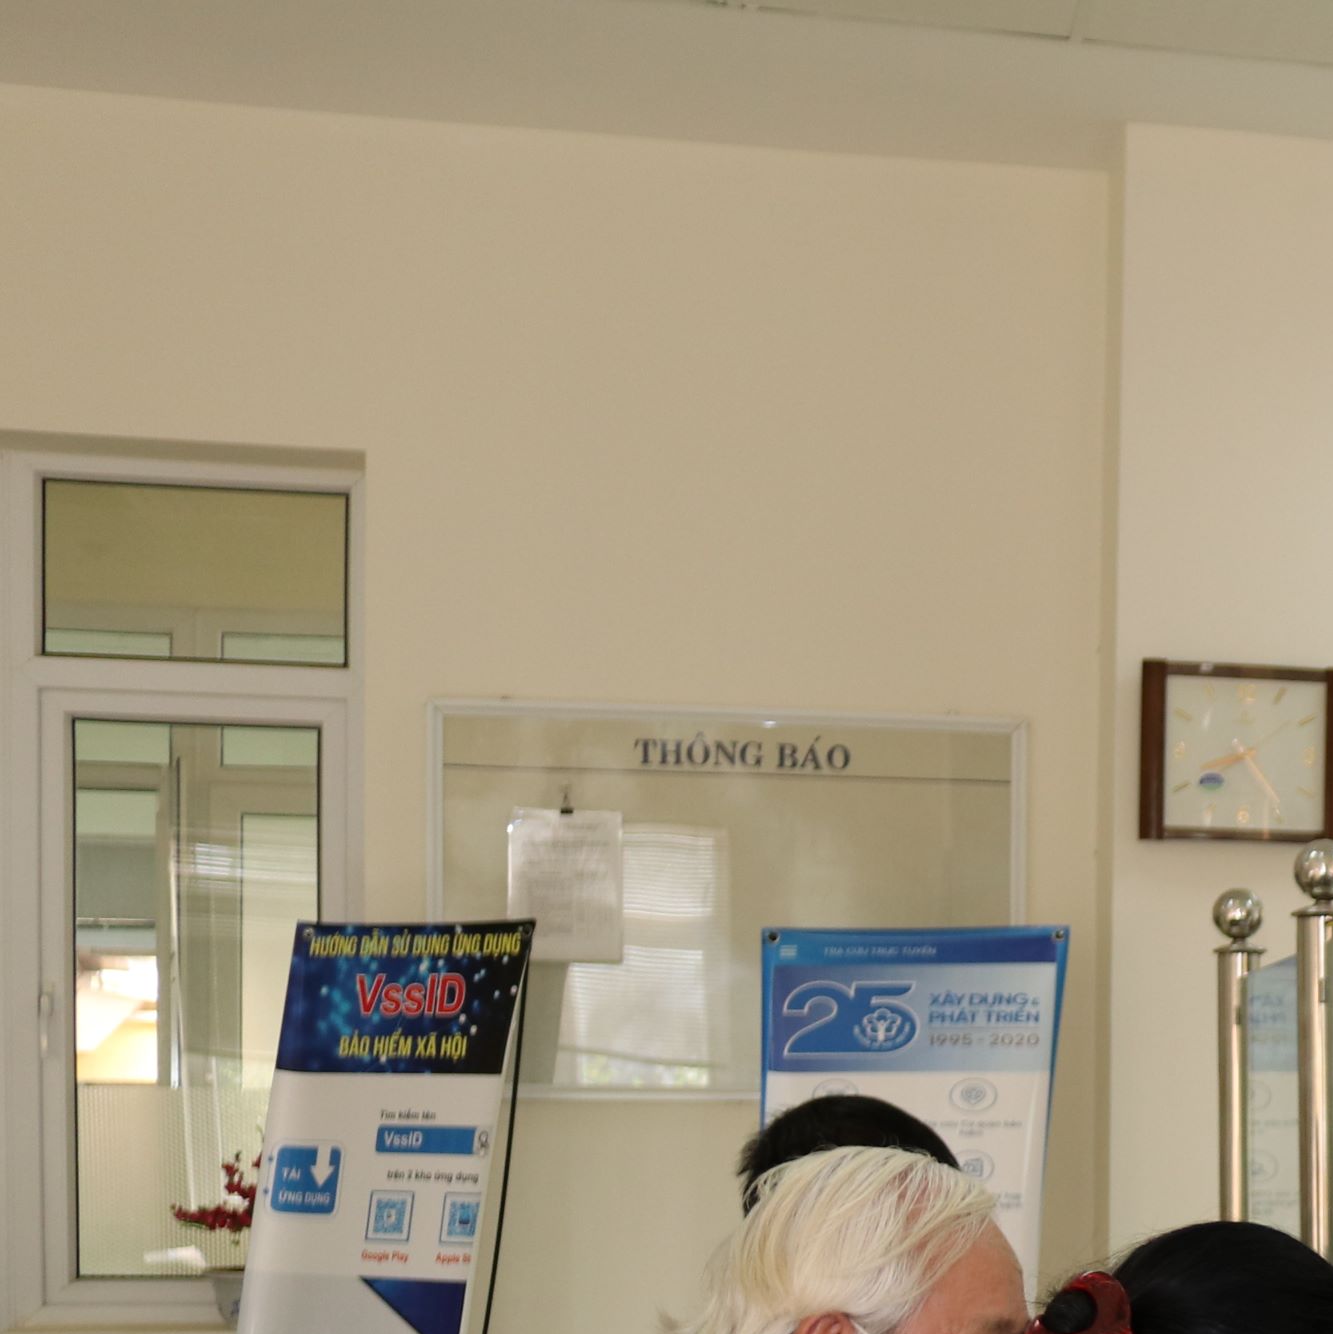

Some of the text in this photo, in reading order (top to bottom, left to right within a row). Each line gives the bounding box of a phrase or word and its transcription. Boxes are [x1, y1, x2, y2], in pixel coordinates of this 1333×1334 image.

[633, 732, 851, 771] THÔNG BÁO
[310, 930, 357, 956] HƯỚNG
[359, 928, 389, 957] DẪN
[391, 928, 411, 957] SỬ
[483, 932, 521, 958] DỤNG
[355, 972, 467, 1018] VssID
[929, 989, 965, 1006] XÂY
[783, 979, 920, 1058] 25
[928, 1005, 1040, 1023] PHÁT TRIỂN
[338, 1029, 370, 1057] BẢO
[415, 1031, 438, 1058] XÃ
[440, 1031, 468, 1062] HỘI
[928, 1032, 973, 1046] 1995
[989, 1032, 1040, 1046] 2020
[383, 1130, 424, 1148] VssID
[278, 1188, 303, 1205] ỨNG
